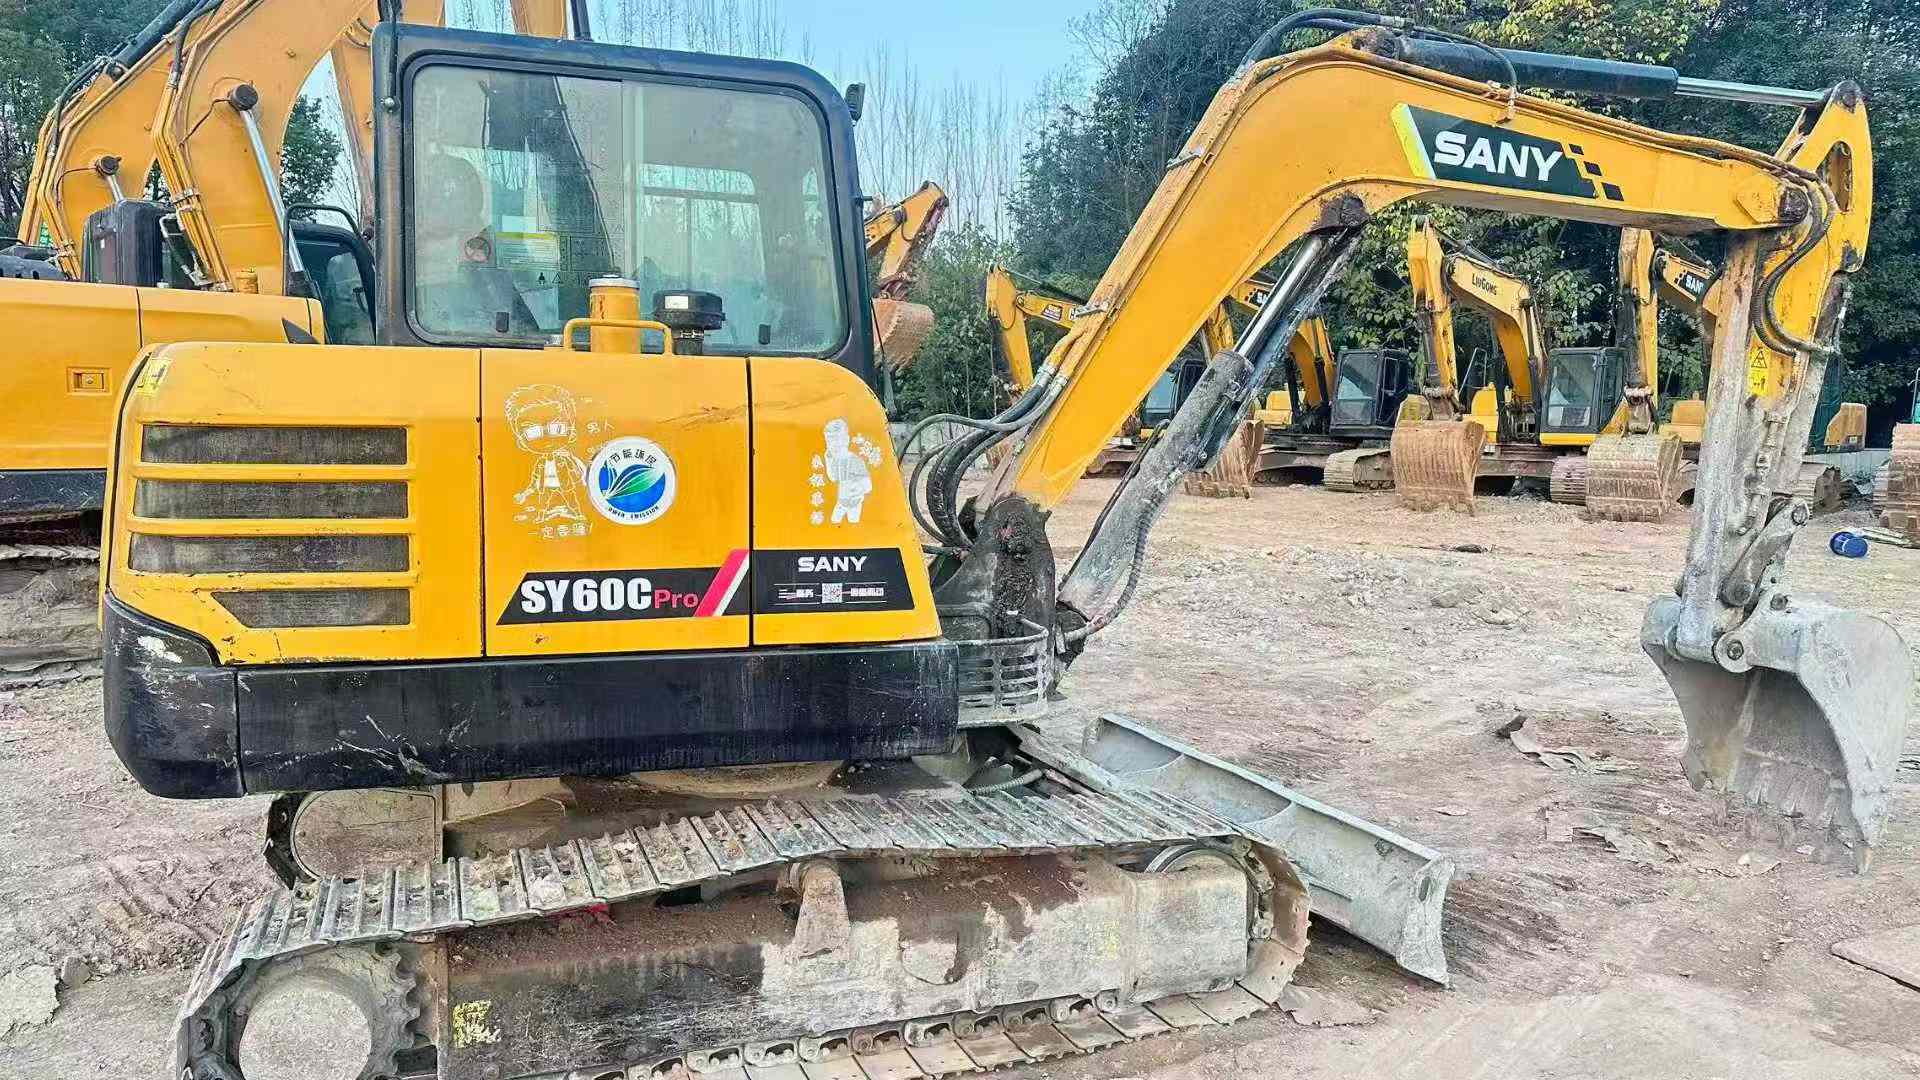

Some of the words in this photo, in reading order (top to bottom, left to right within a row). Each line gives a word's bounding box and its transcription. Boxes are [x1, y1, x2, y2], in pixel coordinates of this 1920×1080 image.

[1434, 131, 1562, 181] SANY
[1685, 274, 1705, 294] SAN
[798, 556, 867, 572] SANY
[520, 577, 652, 614] SY60C
[654, 589, 699, 609] Pro
